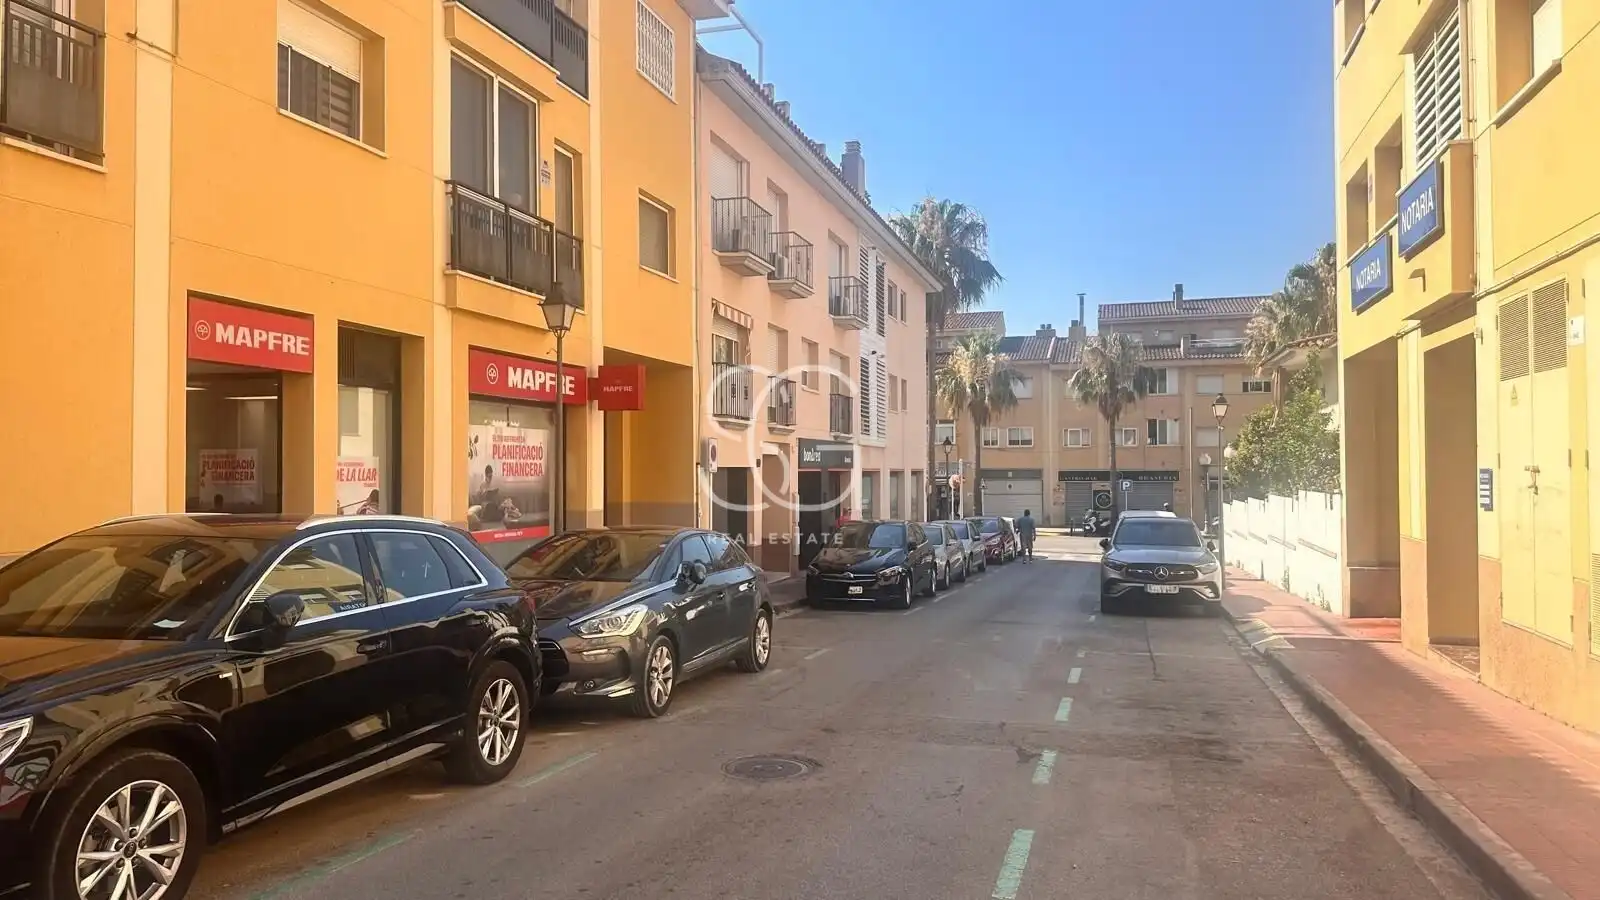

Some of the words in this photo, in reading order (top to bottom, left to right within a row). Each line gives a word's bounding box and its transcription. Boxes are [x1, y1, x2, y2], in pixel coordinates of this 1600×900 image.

[1401, 186, 1435, 235] NOTARIA
[1355, 256, 1381, 293] NOTARIA
[215, 322, 311, 356] MAPFRE
[492, 442, 544, 461] PLANIFICACIÓ
[346, 468, 357, 482] LA
[358, 467, 377, 482] LLAR
[502, 462, 544, 477] FINANCERA
[1122, 481, 1131, 491] P
